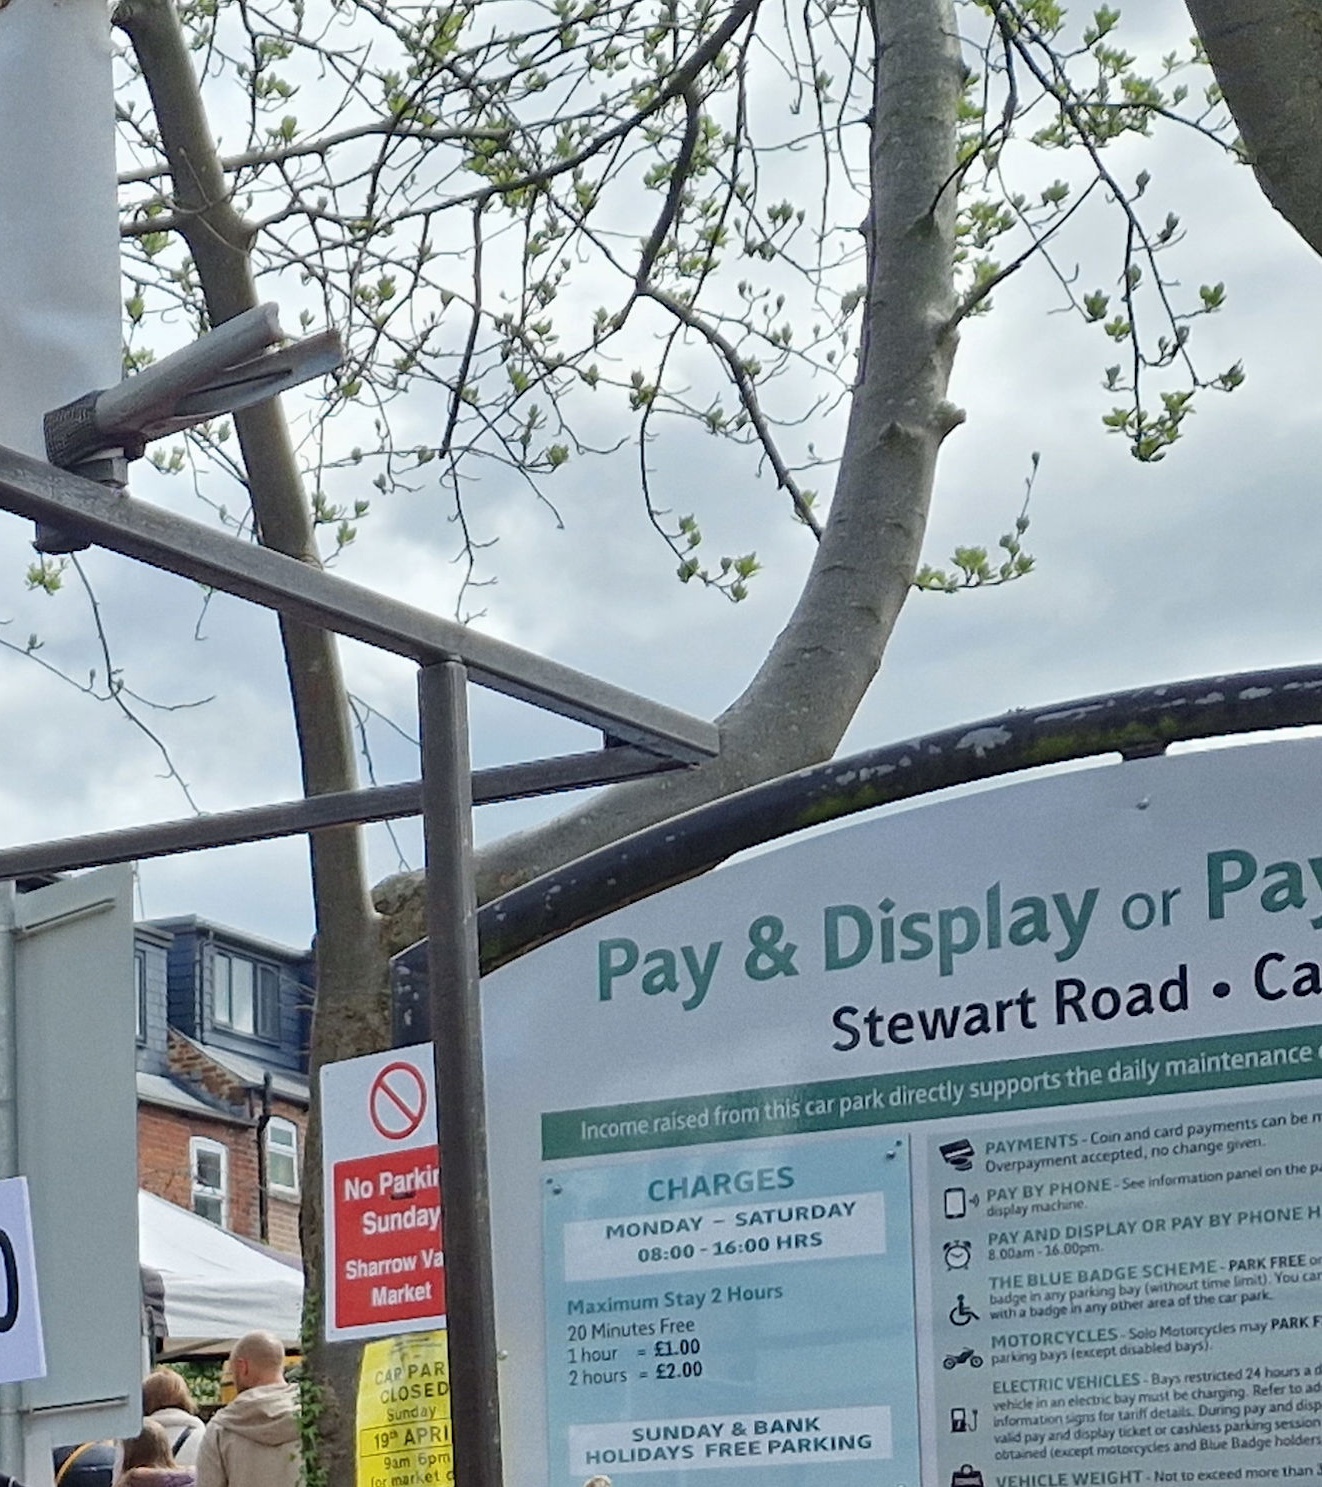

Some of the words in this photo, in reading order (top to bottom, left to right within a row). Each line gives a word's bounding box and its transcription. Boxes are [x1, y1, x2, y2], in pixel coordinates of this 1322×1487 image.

[598, 937, 723, 1012] Pay
[745, 914, 800, 981] &
[824, 880, 1101, 977] Display
[1122, 887, 1182, 931] or
[832, 987, 1038, 1052] Stewart
[1055, 963, 1189, 1026] Road
[581, 1119, 650, 1140] Income
[655, 1108, 708, 1132] raised
[714, 1106, 758, 1126] from
[764, 1098, 800, 1120] this
[805, 1100, 834, 1115] car
[839, 1088, 885, 1118] park
[888, 1079, 964, 1107] directly
[969, 1072, 1062, 1101] supports
[1065, 1064, 1103, 1088] the
[1108, 1060, 1159, 1085] daily
[1165, 1045, 1312, 1077] maintenance
[985, 1133, 1078, 1155] PAYMENTS
[1090, 1131, 1121, 1146] Coin
[1124, 1126, 1150, 1141] and
[1154, 1123, 1183, 1139] card
[1187, 1118, 1257, 1139] payments
[1262, 1115, 1287, 1129] can
[1290, 1111, 1308, 1125] be
[985, 1154, 1078, 1174] Overpayment
[1080, 1146, 1148, 1164] accepted,
[1151, 1146, 1169, 1158] no
[1173, 1141, 1223, 1157] change
[344, 1176, 373, 1201] No
[648, 1166, 794, 1202] CHARGES
[987, 1186, 1018, 1201] PAY
[1022, 1184, 1044, 1199] BY
[1049, 1178, 1112, 1196] PHONE
[1122, 1177, 1145, 1190] See
[1148, 1171, 1223, 1187] information
[1226, 1166, 1262, 1183] panel
[1265, 1166, 1281, 1176] on
[1285, 1163, 1307, 1175] the
[362, 1203, 442, 1236] Sunday
[606, 1216, 703, 1240] MONDAY
[735, 1201, 857, 1227] SATURDAY
[988, 1231, 1019, 1246] PAY
[1023, 1227, 1061, 1243] AND
[1065, 1220, 1138, 1239] DISPLAY
[1142, 1218, 1166, 1233] OR
[1171, 1215, 1204, 1231] PAY
[1209, 1212, 1232, 1227] BY
[1238, 1206, 1303, 1225] PHONE
[638, 1244, 694, 1263] 08:00
[713, 1237, 770, 1256] 16:00
[776, 1231, 823, 1250] HRS
[345, 1255, 417, 1280] Sharrow
[989, 1275, 1024, 1290] THE
[1027, 1270, 1073, 1287] BLUE
[1077, 1266, 1138, 1283] BADGE
[1142, 1259, 1217, 1279] SCHEME
[1229, 1257, 1266, 1272] PARK
[1270, 1254, 1307, 1269] FREE
[371, 1281, 432, 1307] Market
[567, 1295, 658, 1316] Maximum
[664, 1290, 706, 1310] Stay
[711, 1288, 723, 1304] 2
[727, 1283, 784, 1302] Hours
[567, 1324, 587, 1342] 20
[591, 1320, 655, 1340] Minutes
[660, 1318, 696, 1336] Free
[991, 1328, 1118, 1349] MOTORCYCLES
[567, 1347, 577, 1364] 1
[581, 1345, 618, 1363] hour
[654, 1338, 701, 1357] £1.00
[375, 1366, 402, 1386] CAR
[569, 1371, 579, 1386] 2
[583, 1367, 628, 1385] hours
[655, 1361, 703, 1380] £2.00
[993, 1377, 1064, 1394] ELECTRIC
[1066, 1373, 1141, 1390] VEHICLES
[380, 1381, 449, 1404] CLOSED
[386, 1405, 437, 1423] Sunday
[631, 1423, 723, 1443] SUNDAY
[731, 1422, 746, 1436] &
[753, 1417, 820, 1435] BANK
[383, 1455, 411, 1470] 9am
[418, 1452, 451, 1471] 6pm
[585, 1444, 694, 1466] HOLIDAYS
[705, 1440, 762, 1458] FREE
[767, 1434, 872, 1453] PARKING
[391, 1471, 440, 1487] market
[1072, 1470, 1144, 1487] WEIGHT
